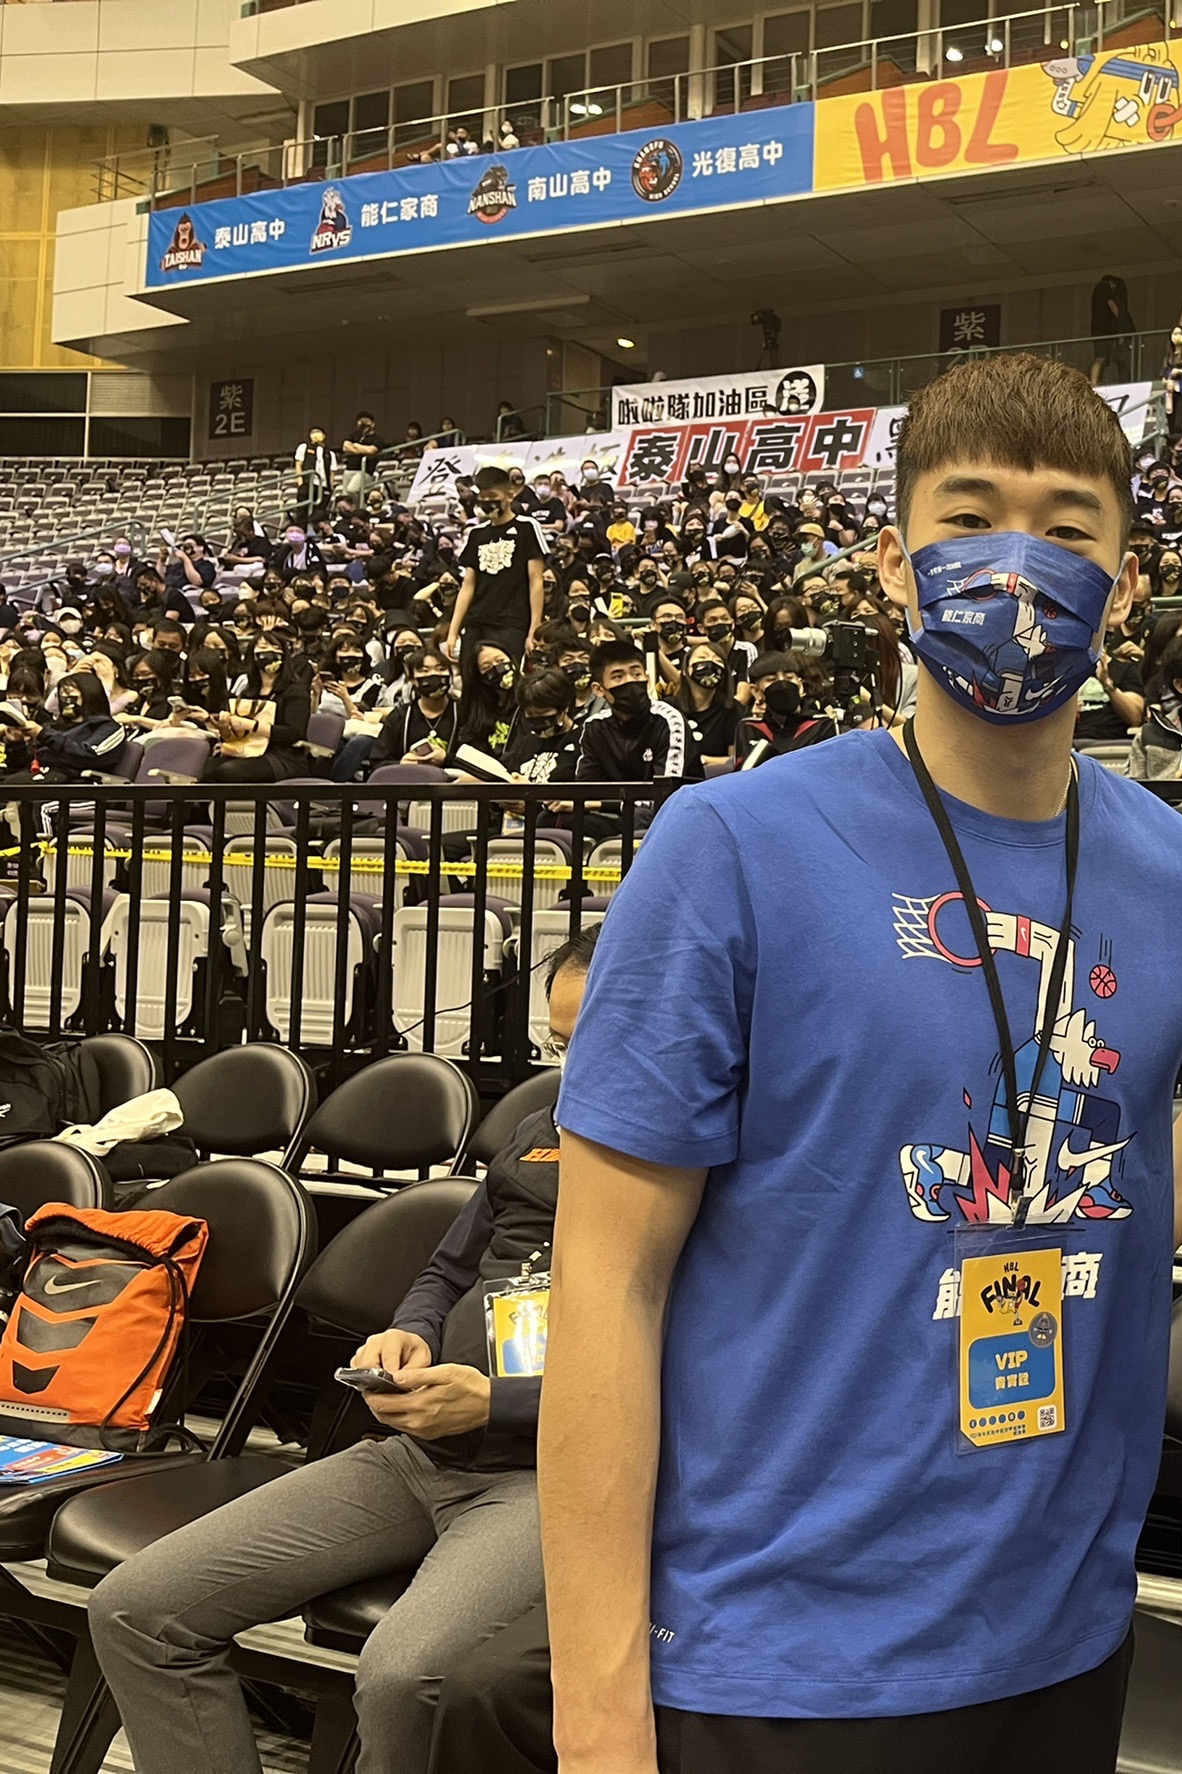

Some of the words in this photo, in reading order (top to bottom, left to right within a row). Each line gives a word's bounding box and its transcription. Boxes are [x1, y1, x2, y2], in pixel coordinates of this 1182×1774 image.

[855, 70, 1019, 183] HBL
[692, 140, 784, 178] 光復高中
[527, 167, 612, 202] 南山高中
[361, 194, 438, 227] 能仁家商
[467, 190, 517, 213] NANSHAN
[214, 218, 285, 249] 泰山高中
[164, 249, 202, 269] TAISHAN
[953, 311, 986, 341] 紫
[219, 384, 243, 410] 紫
[214, 412, 245, 435] 2E
[627, 416, 867, 484] 泰山高中
[1003, 1261, 1019, 1273] HBL
[980, 1273, 1041, 1314] FINAL
[995, 1349, 1029, 1371] VIP
